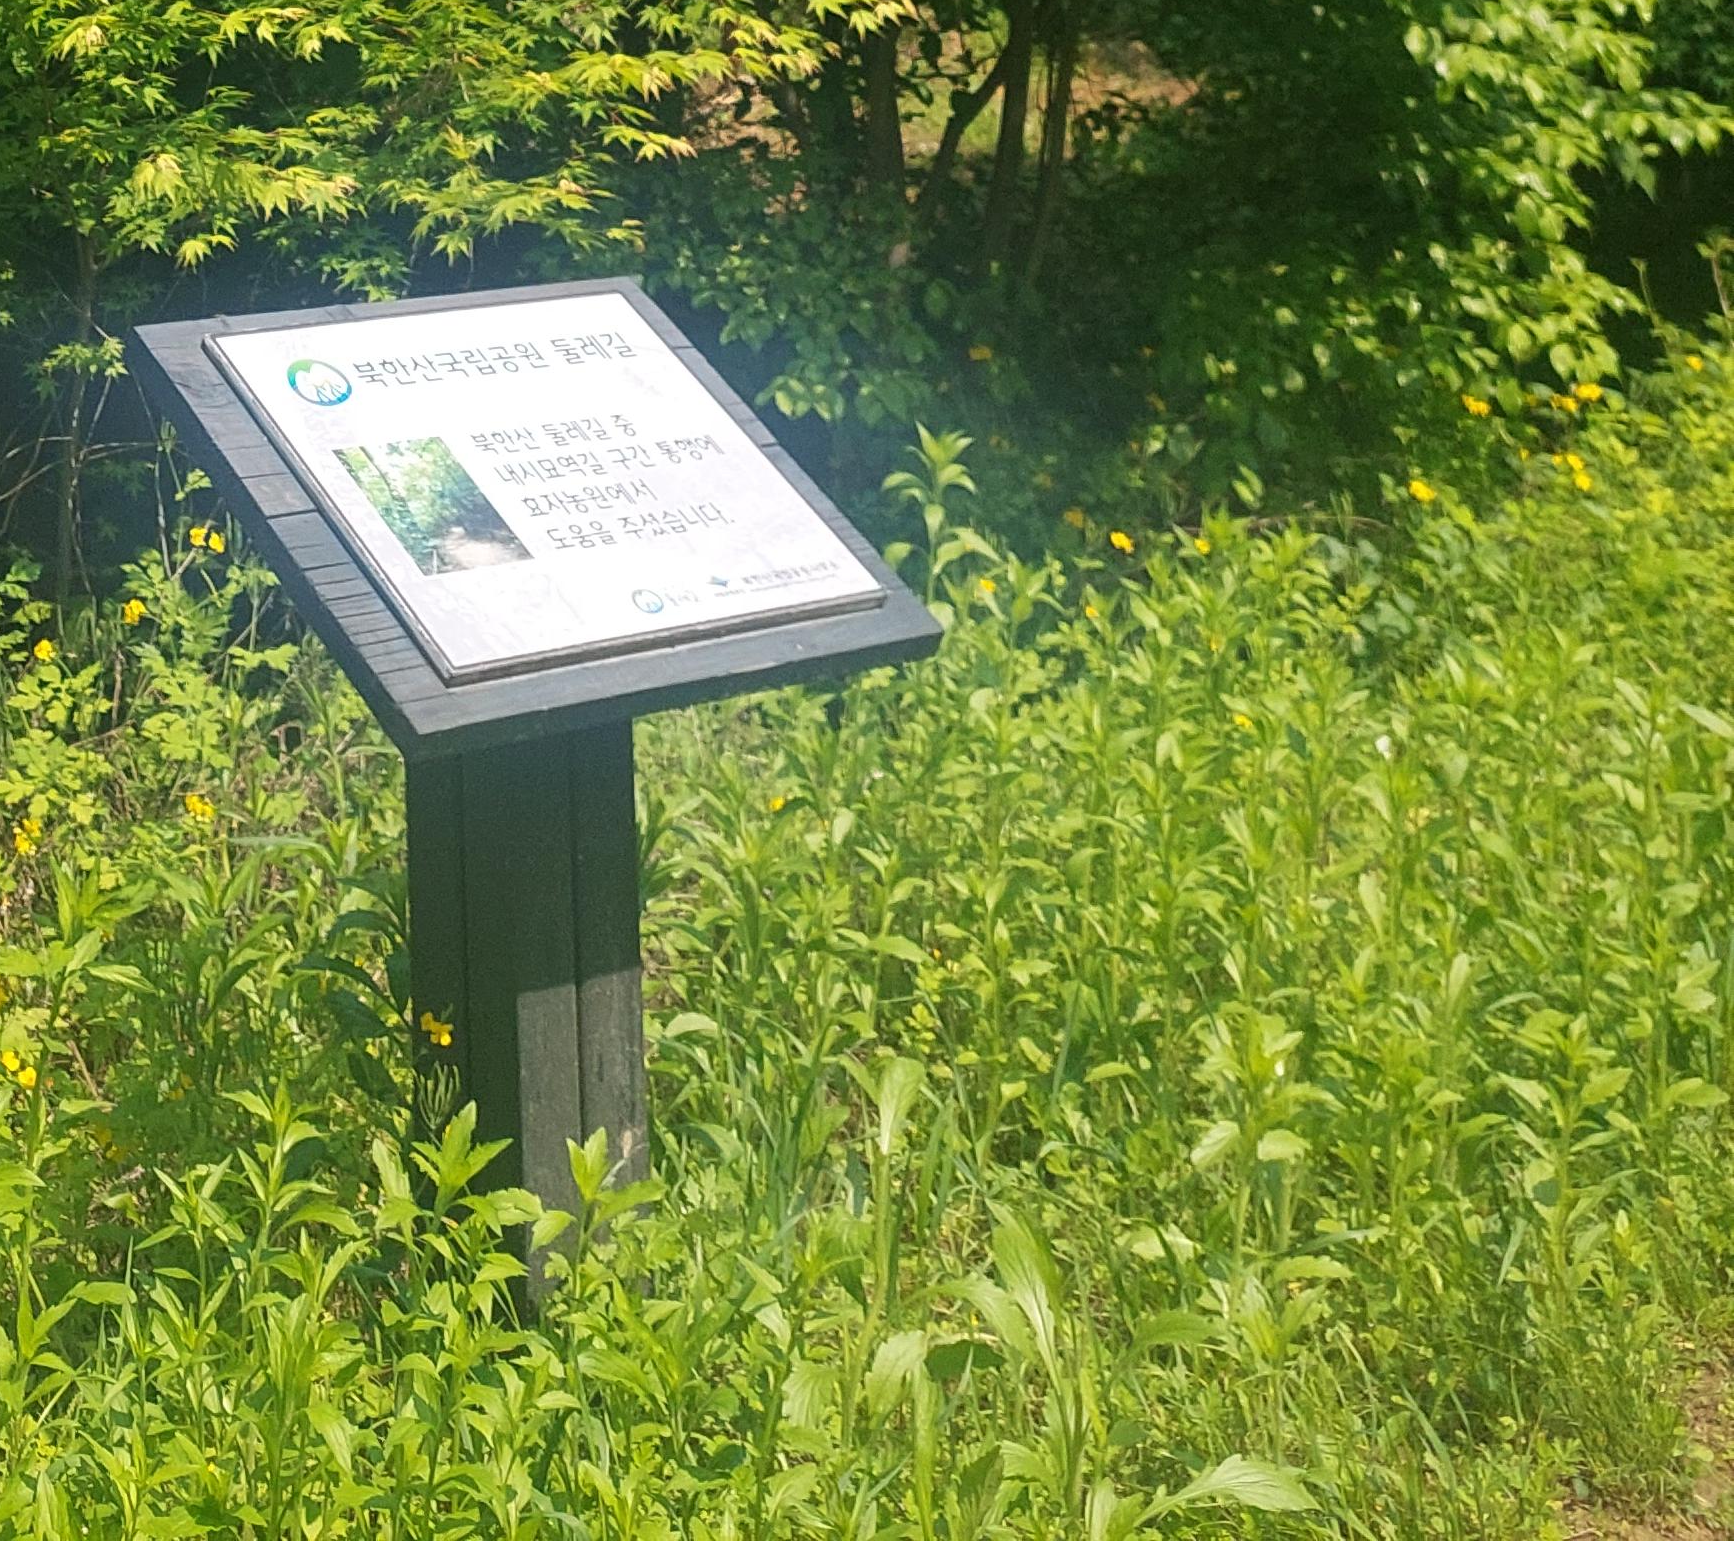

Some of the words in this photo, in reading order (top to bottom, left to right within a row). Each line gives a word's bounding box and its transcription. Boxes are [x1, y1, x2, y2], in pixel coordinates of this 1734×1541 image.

[353, 341, 551, 388] 북한산국립공원
[550, 332, 638, 365] 둘레길
[470, 426, 541, 454] 북한산
[541, 417, 612, 446] 둘레길
[610, 414, 637, 437] 중
[494, 451, 608, 485] 내시묘역길
[606, 444, 656, 470] 구간
[654, 434, 725, 464] 통행에
[521, 478, 658, 517] 효자농원에서
[546, 520, 618, 549] 도움을
[617, 502, 736, 537] 주셨습니다.
